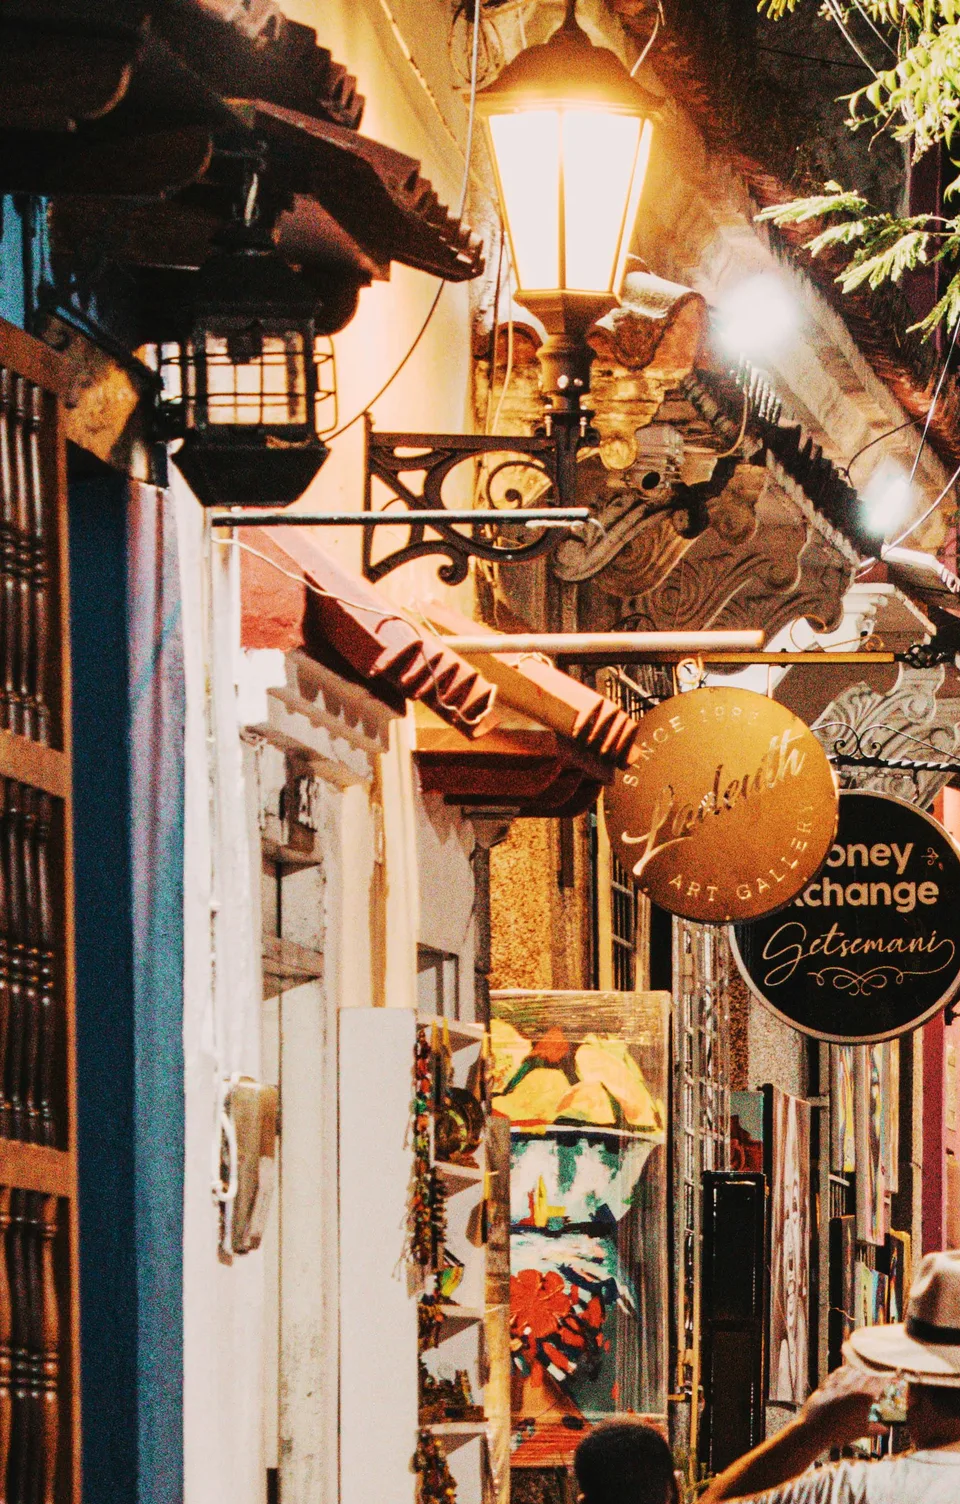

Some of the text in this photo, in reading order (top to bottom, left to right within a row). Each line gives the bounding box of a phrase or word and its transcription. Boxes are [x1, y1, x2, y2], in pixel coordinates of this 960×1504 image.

[623, 715, 687, 788] SINCE
[669, 803, 814, 902] ART GALLERY
[826, 842, 914, 875] oney
[762, 921, 955, 987] Getsemani
